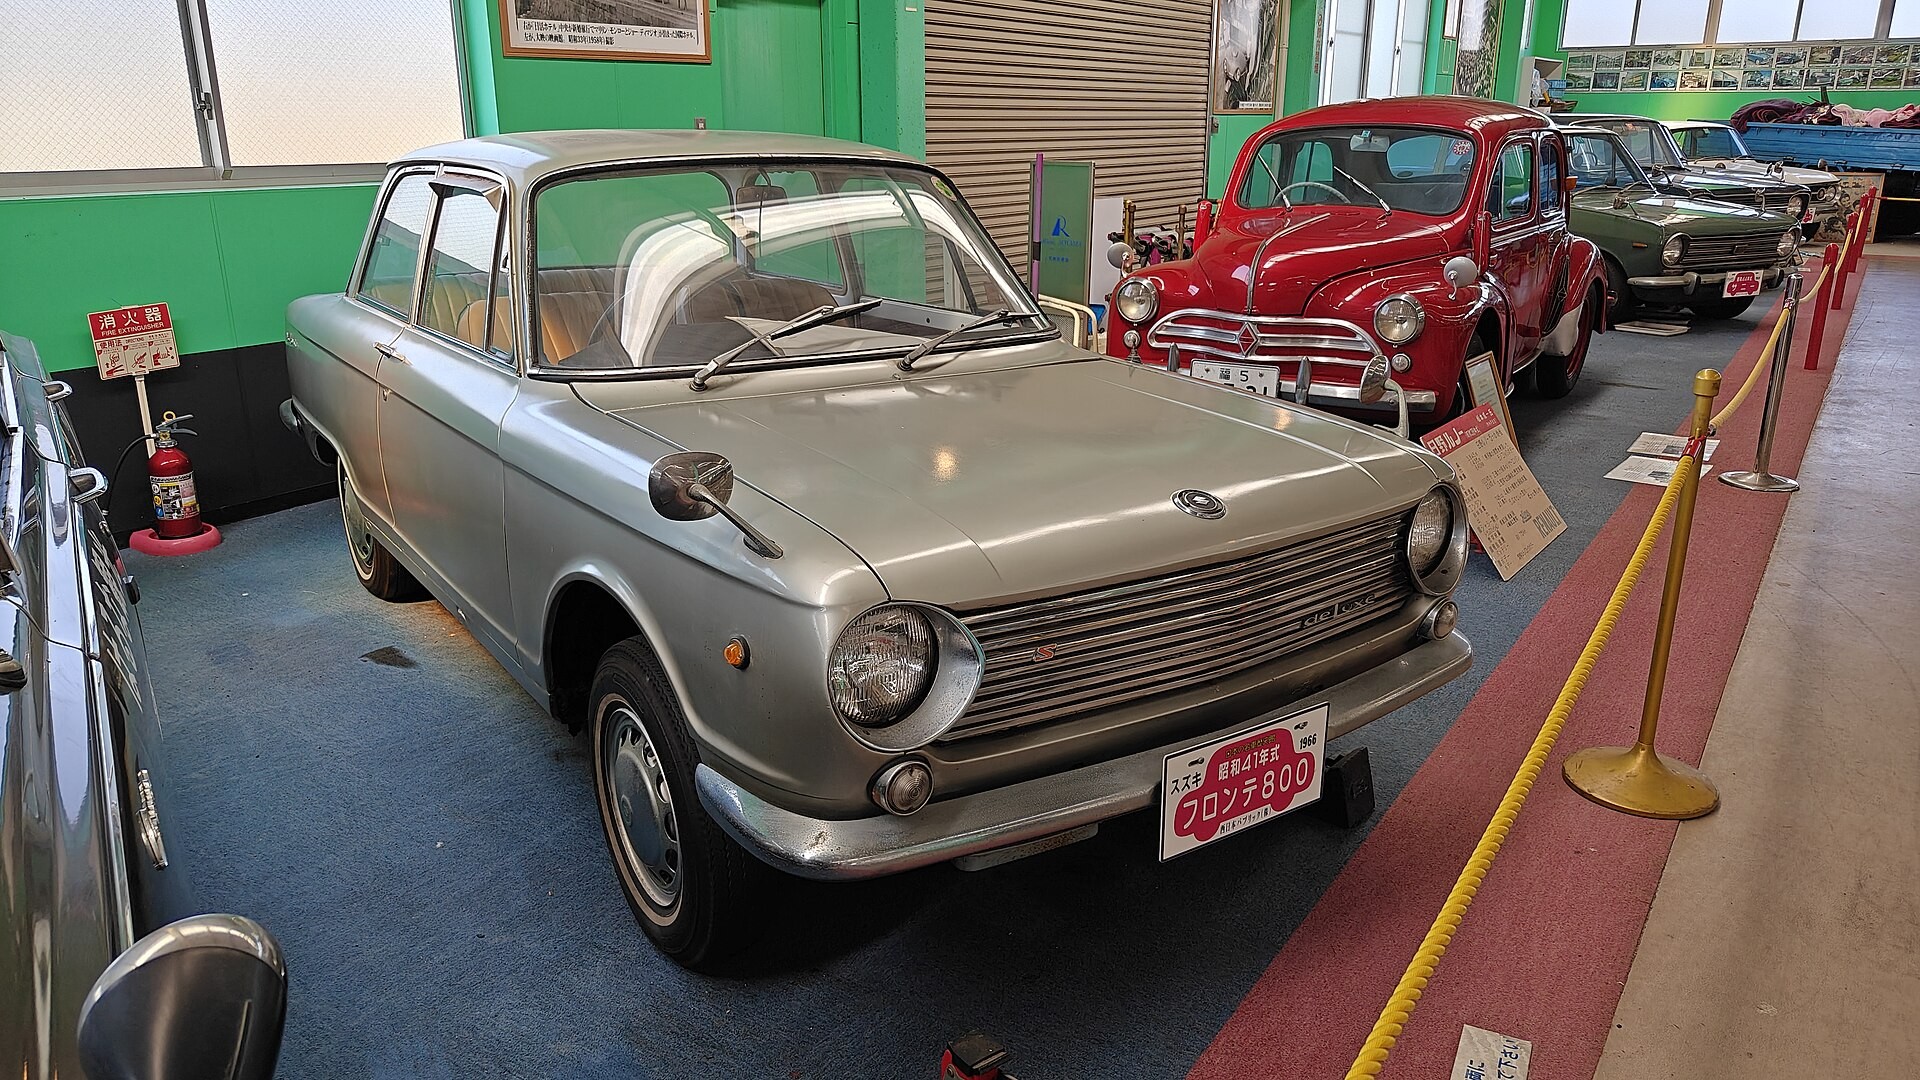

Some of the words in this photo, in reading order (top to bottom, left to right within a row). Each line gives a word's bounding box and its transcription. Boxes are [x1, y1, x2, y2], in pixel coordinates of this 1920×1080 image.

[98, 307, 162, 331] 消火器
[101, 328, 117, 337] FIRE
[117, 321, 165, 335] EXTINGUISHER
[99, 338, 123, 349] 使用法
[1239, 370, 1249, 382] 5
[1426, 427, 1464, 456] 日野ルノー
[1532, 505, 1562, 539] RENAULT
[1303, 593, 1376, 628] deluxe
[1298, 732, 1318, 750] 1966
[1217, 743, 1280, 783] 昭和41年式
[1170, 771, 1203, 796] スズキ
[1182, 757, 1310, 831] フロンテ800
